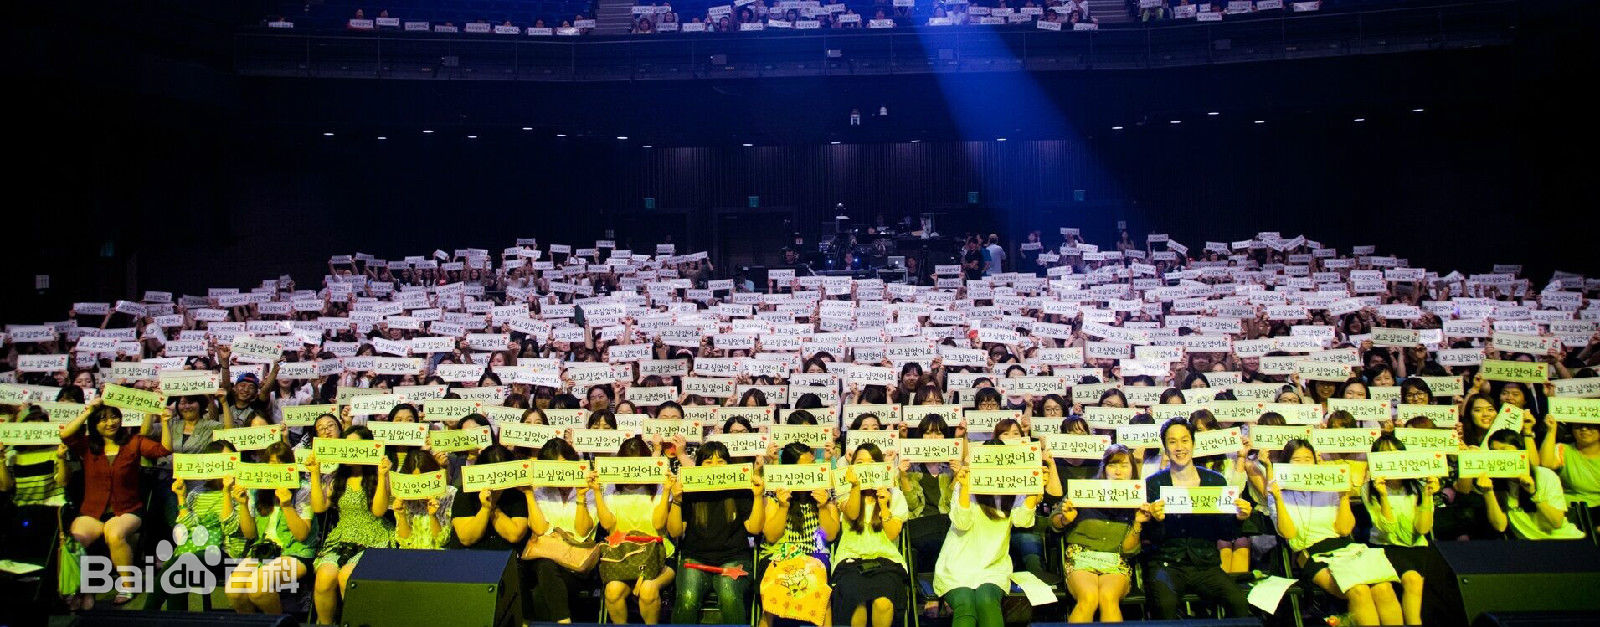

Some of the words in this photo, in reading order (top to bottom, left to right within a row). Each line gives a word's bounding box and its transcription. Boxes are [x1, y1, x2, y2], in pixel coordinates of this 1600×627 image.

[113, 367, 158, 376] 보고싶었어요
[1484, 367, 1542, 377] 보고싶었어요
[164, 382, 215, 390] 보고싶었어요
[1210, 377, 1238, 385] 싶었어요
[686, 383, 731, 392] 보고싶었어요
[1018, 383, 1063, 392] 보고싶었어요
[1430, 382, 1460, 391] 싶었어요
[106, 391, 162, 409] 보고싶었어요
[407, 392, 440, 401] 고싶었어요
[462, 391, 501, 400] 고싶었어요
[630, 392, 673, 401] 보고싶었어요
[353, 401, 402, 410] 보고싶었어요
[428, 406, 478, 416] 보고싶었어요
[1214, 408, 1261, 417] 보고싶었어요
[549, 414, 582, 424] 싶었어요
[2, 428, 61, 439] 보고싶었어요
[646, 427, 698, 437] 보고싶었어요
[434, 436, 489, 447] 보고싶었어요
[773, 433, 826, 443] 보고싶었어요
[1201, 437, 1238, 448] 싶었어요
[1317, 437, 1376, 447] 보고싶었어요
[1401, 437, 1458, 448] 보고싶었어요
[723, 439, 766, 450] 고싶었어요
[317, 446, 379, 458] 보고싶었어요
[903, 446, 959, 457] 보고싶었어요
[973, 452, 1036, 465] 보고싶었어요
[176, 463, 235, 473] 보고싶었어요
[1375, 459, 1441, 471] 보고싶었어요
[1464, 460, 1526, 471] 보고싶었어요
[534, 470, 585, 480] 고싶었어요
[601, 465, 662, 477] 보고싶었어요
[468, 471, 528, 484] 보고싶었어요
[685, 474, 746, 486] 보고싶었어요
[768, 473, 825, 485] 보고싶었어요
[839, 468, 889, 485] 보싶었어요
[973, 475, 1038, 488] 보고싶었어요
[1280, 474, 1345, 484] 보고싶었어요
[392, 479, 440, 495] 고싶었어요
[1073, 489, 1141, 501] 보고싶었어요
[1165, 497, 1233, 508] 보고싶었어요
